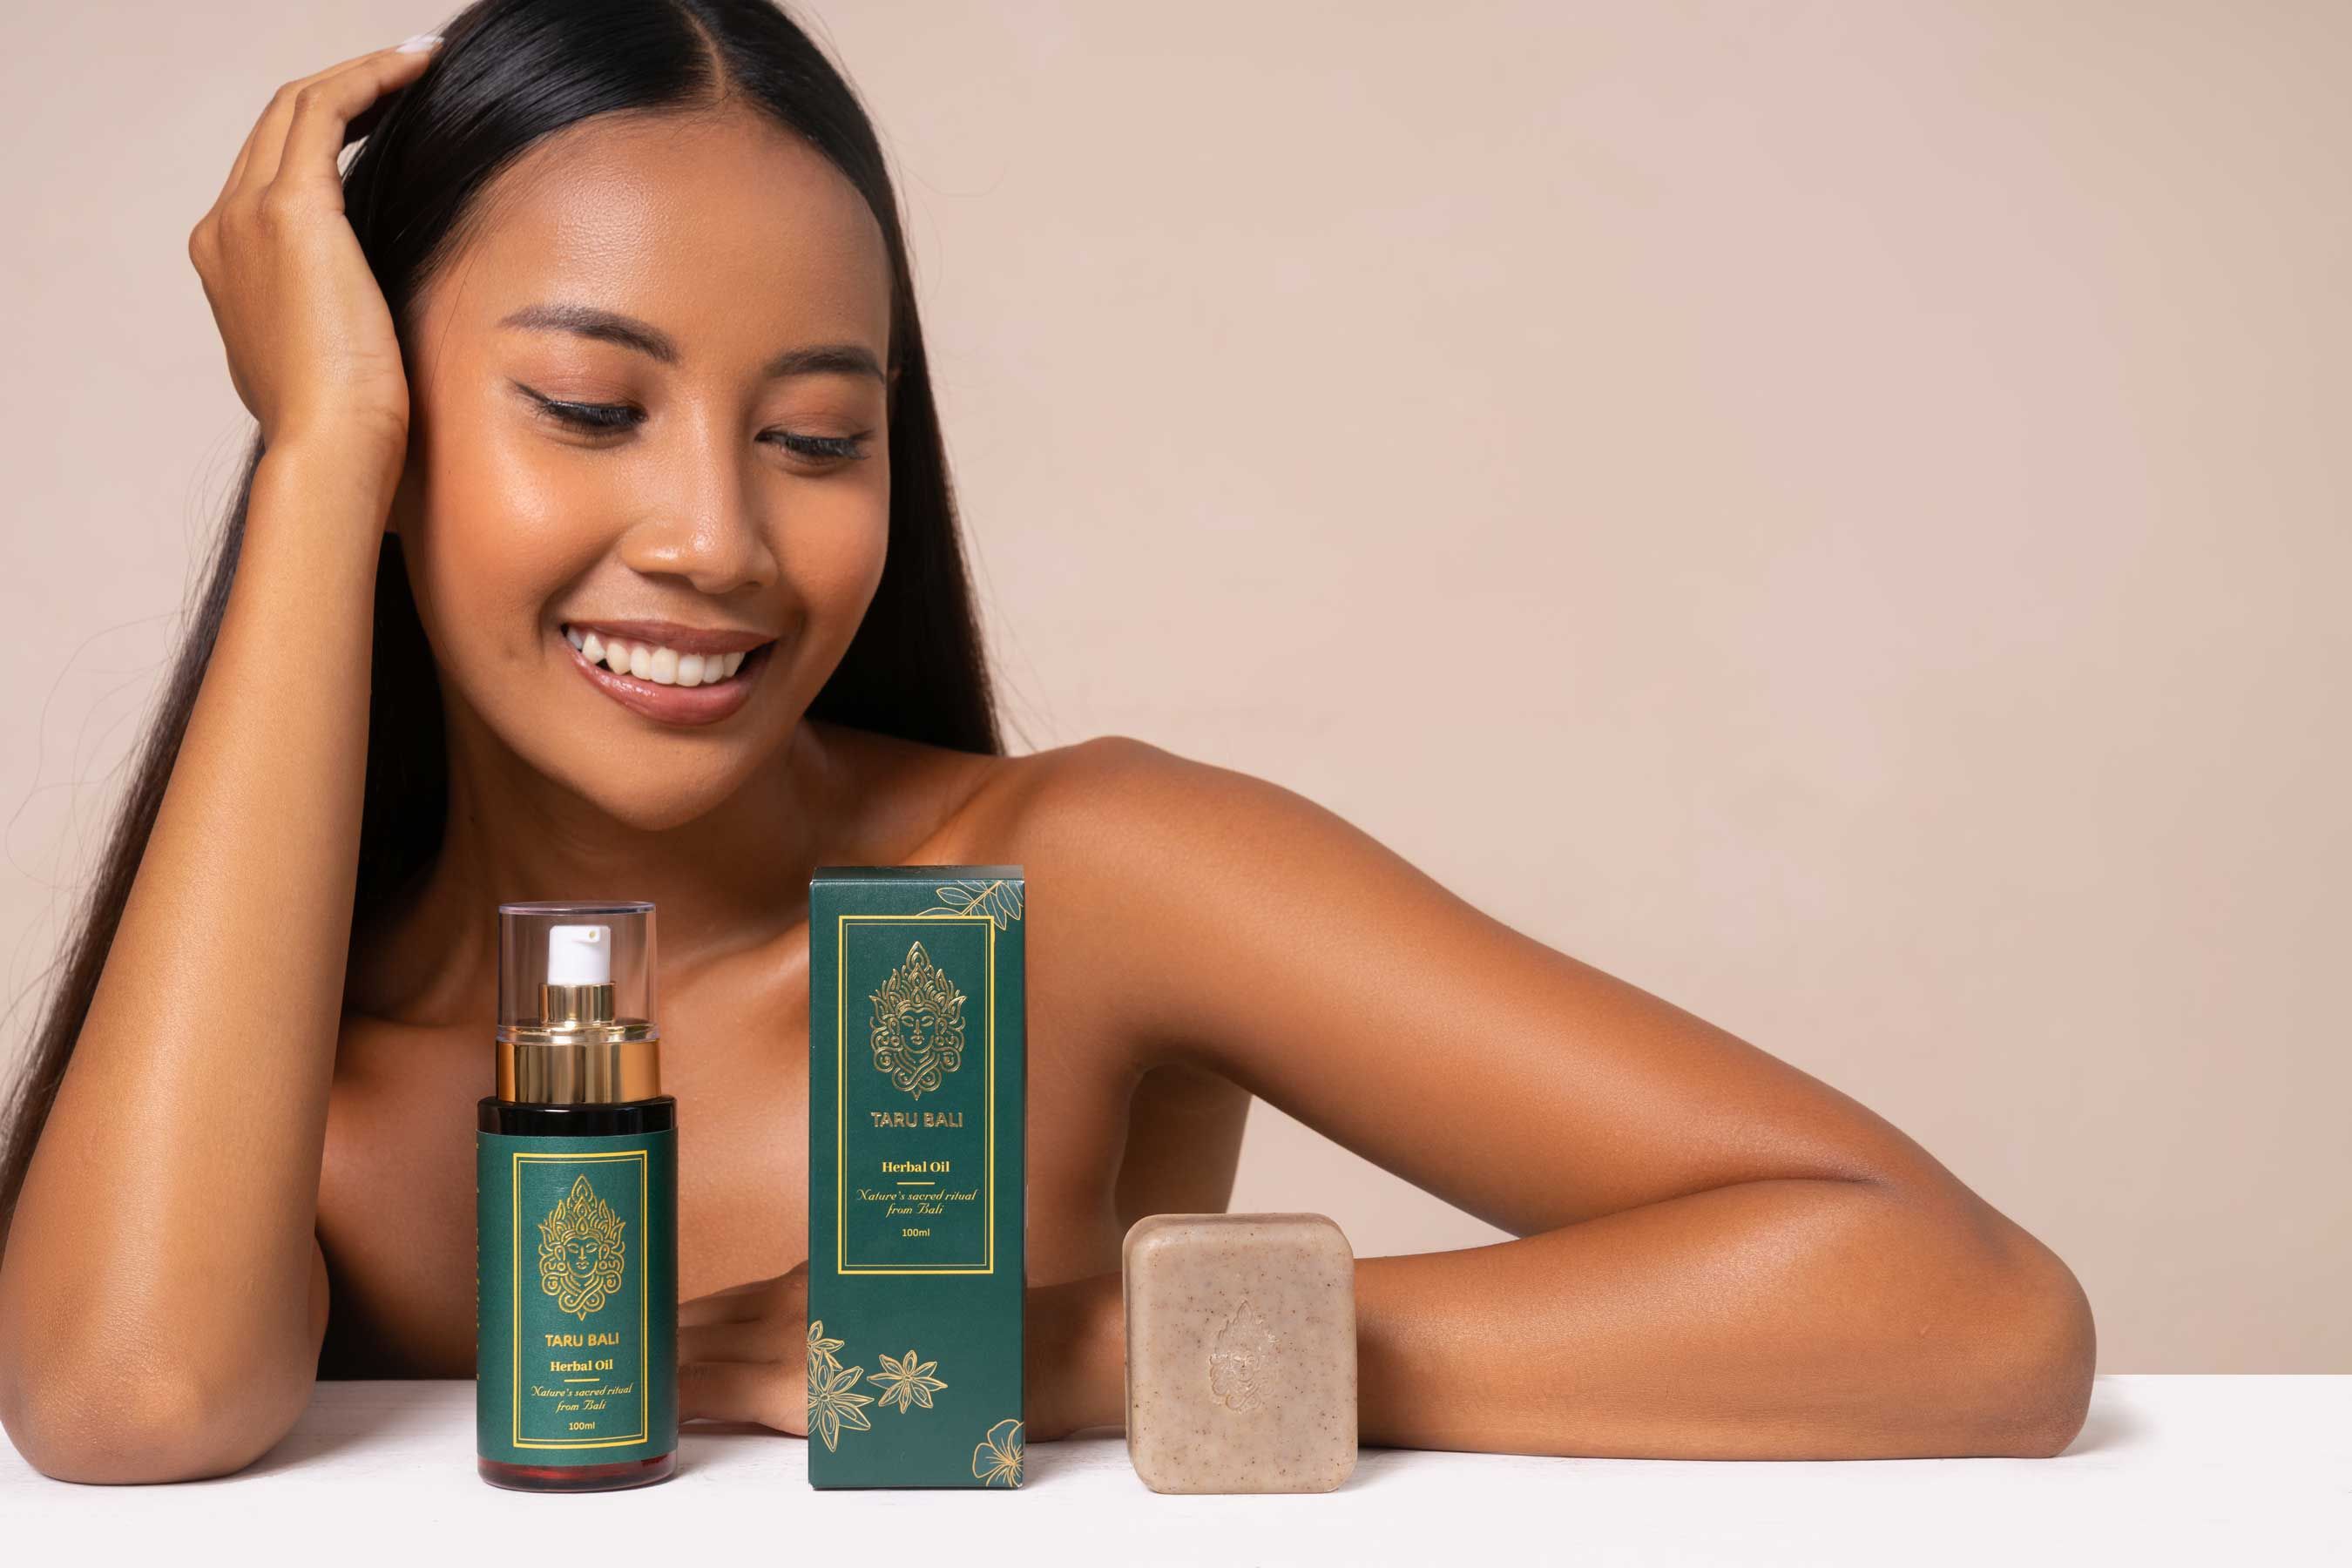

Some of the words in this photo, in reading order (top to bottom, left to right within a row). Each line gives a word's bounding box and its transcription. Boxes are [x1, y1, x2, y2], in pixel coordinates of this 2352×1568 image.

[870, 1112, 918, 1128] TARU
[923, 1112, 963, 1128] BALI
[882, 1160, 928, 1173] Herbal
[929, 1160, 950, 1173] Oil
[857, 1188, 905, 1200] Nature's
[908, 1188, 945, 1201] sacred
[944, 1188, 979, 1201] ritual
[885, 1202, 913, 1219] from
[916, 1202, 944, 1214] Bali
[902, 1228, 930, 1237] 100ml
[544, 1334, 584, 1348] TARU
[587, 1332, 619, 1347] BALI
[550, 1360, 593, 1372] Herbal
[594, 1359, 613, 1370] Oil
[531, 1385, 572, 1397] Nature's
[574, 1384, 608, 1396] sacred
[606, 1382, 634, 1395] ritual
[555, 1400, 579, 1414] from
[580, 1399, 607, 1410] Bali
[568, 1422, 596, 1430] 100ml
